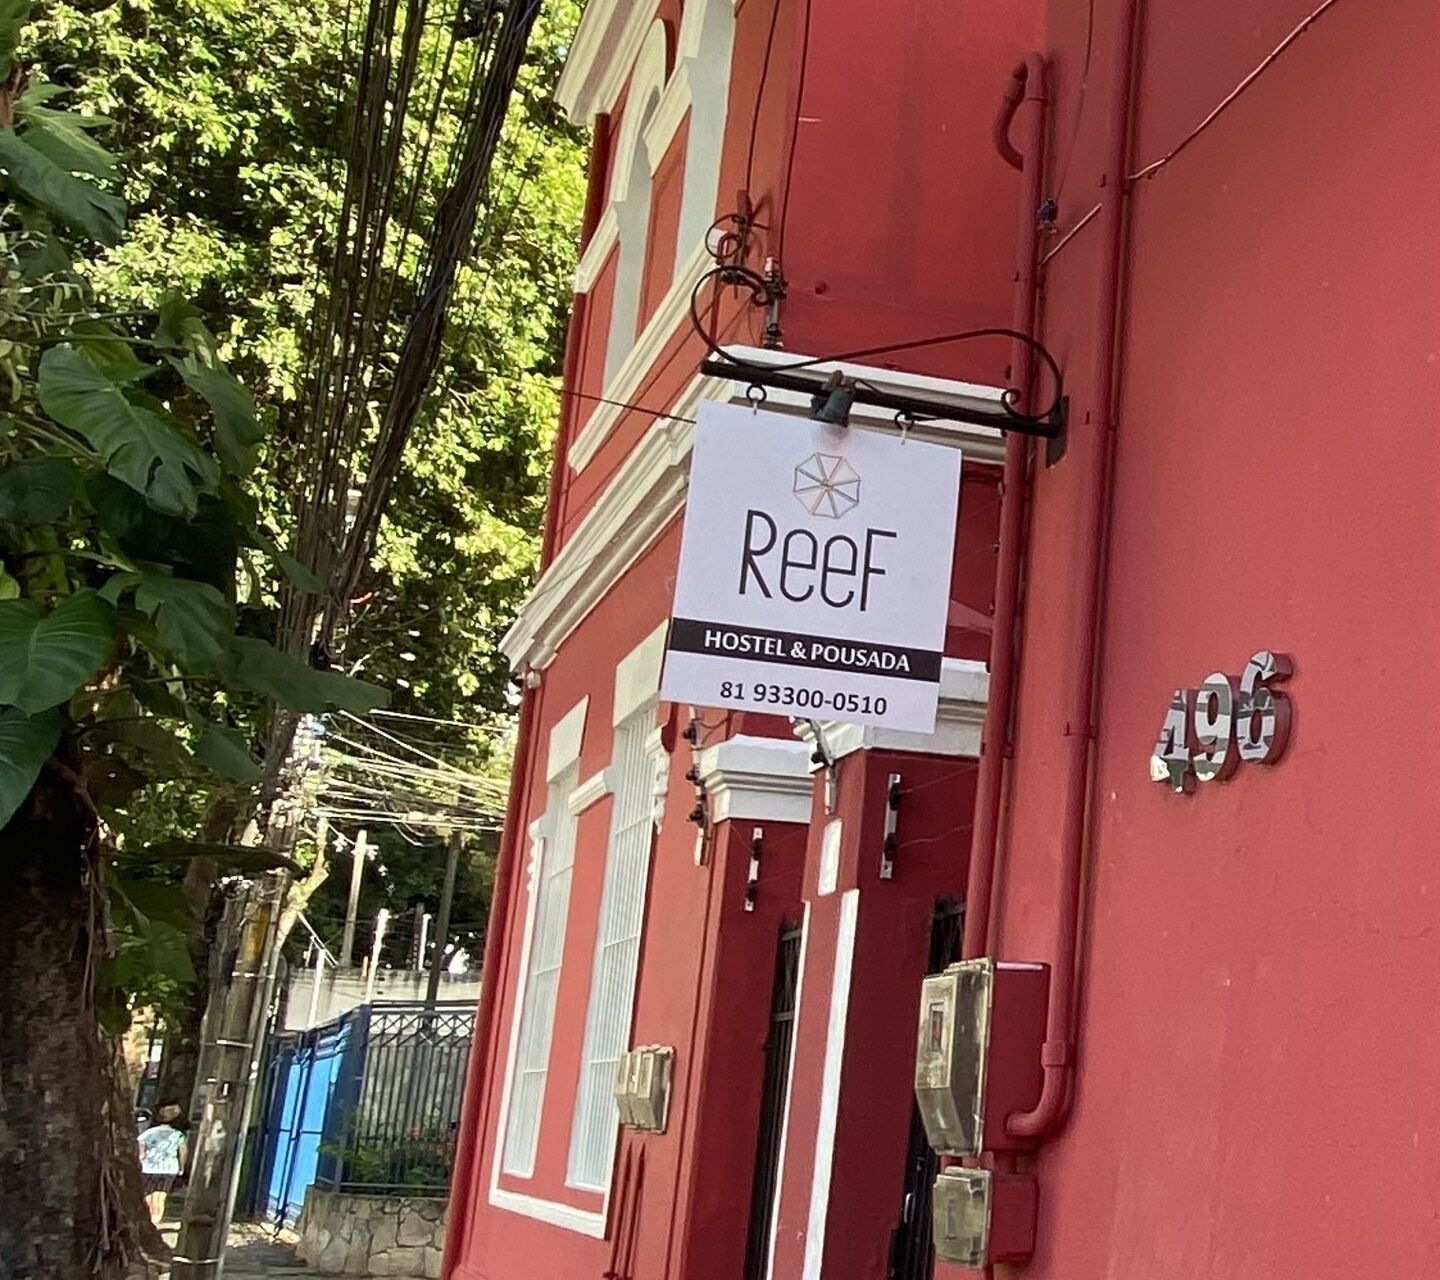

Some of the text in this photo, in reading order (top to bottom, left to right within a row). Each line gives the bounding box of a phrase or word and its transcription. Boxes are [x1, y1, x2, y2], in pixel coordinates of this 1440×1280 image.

[703, 629, 911, 673] HOSTEL & POUSADA
[719, 681, 888, 717] 81 93300-0510
[1150, 649, 1284, 794] 496
